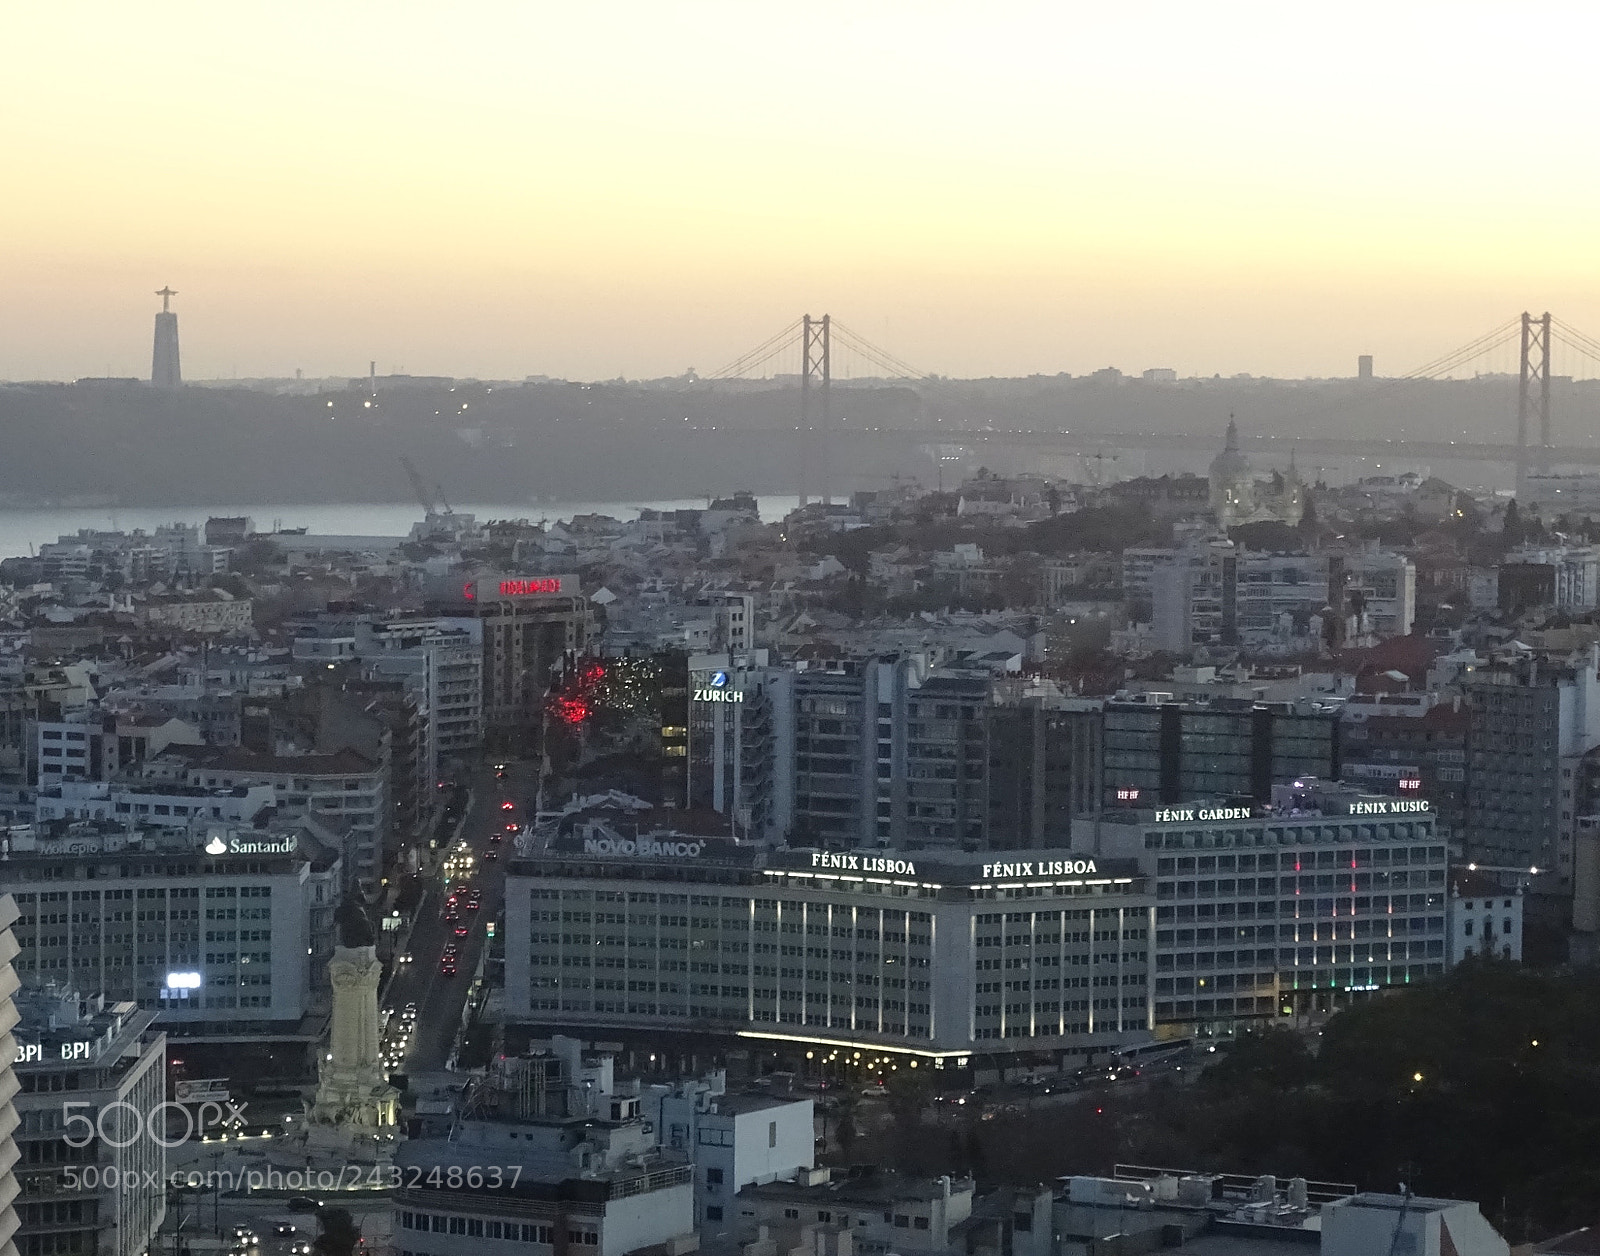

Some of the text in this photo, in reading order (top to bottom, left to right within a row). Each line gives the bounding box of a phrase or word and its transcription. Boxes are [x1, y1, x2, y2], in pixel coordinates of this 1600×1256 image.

[693, 690, 744, 702] ZURICH
[1409, 780, 1420, 788] HF
[1155, 808, 1250, 822] FÉNIX GARDEN
[1349, 801, 1429, 814] FÉNIX MUSIC
[584, 839, 701, 857] NOVO BANCO
[812, 851, 916, 875] FÉNIX LISBOA
[983, 860, 1097, 877] FÉNIX LISBOA
[14, 1044, 42, 1062] BPI
[61, 1042, 89, 1059] BPI
